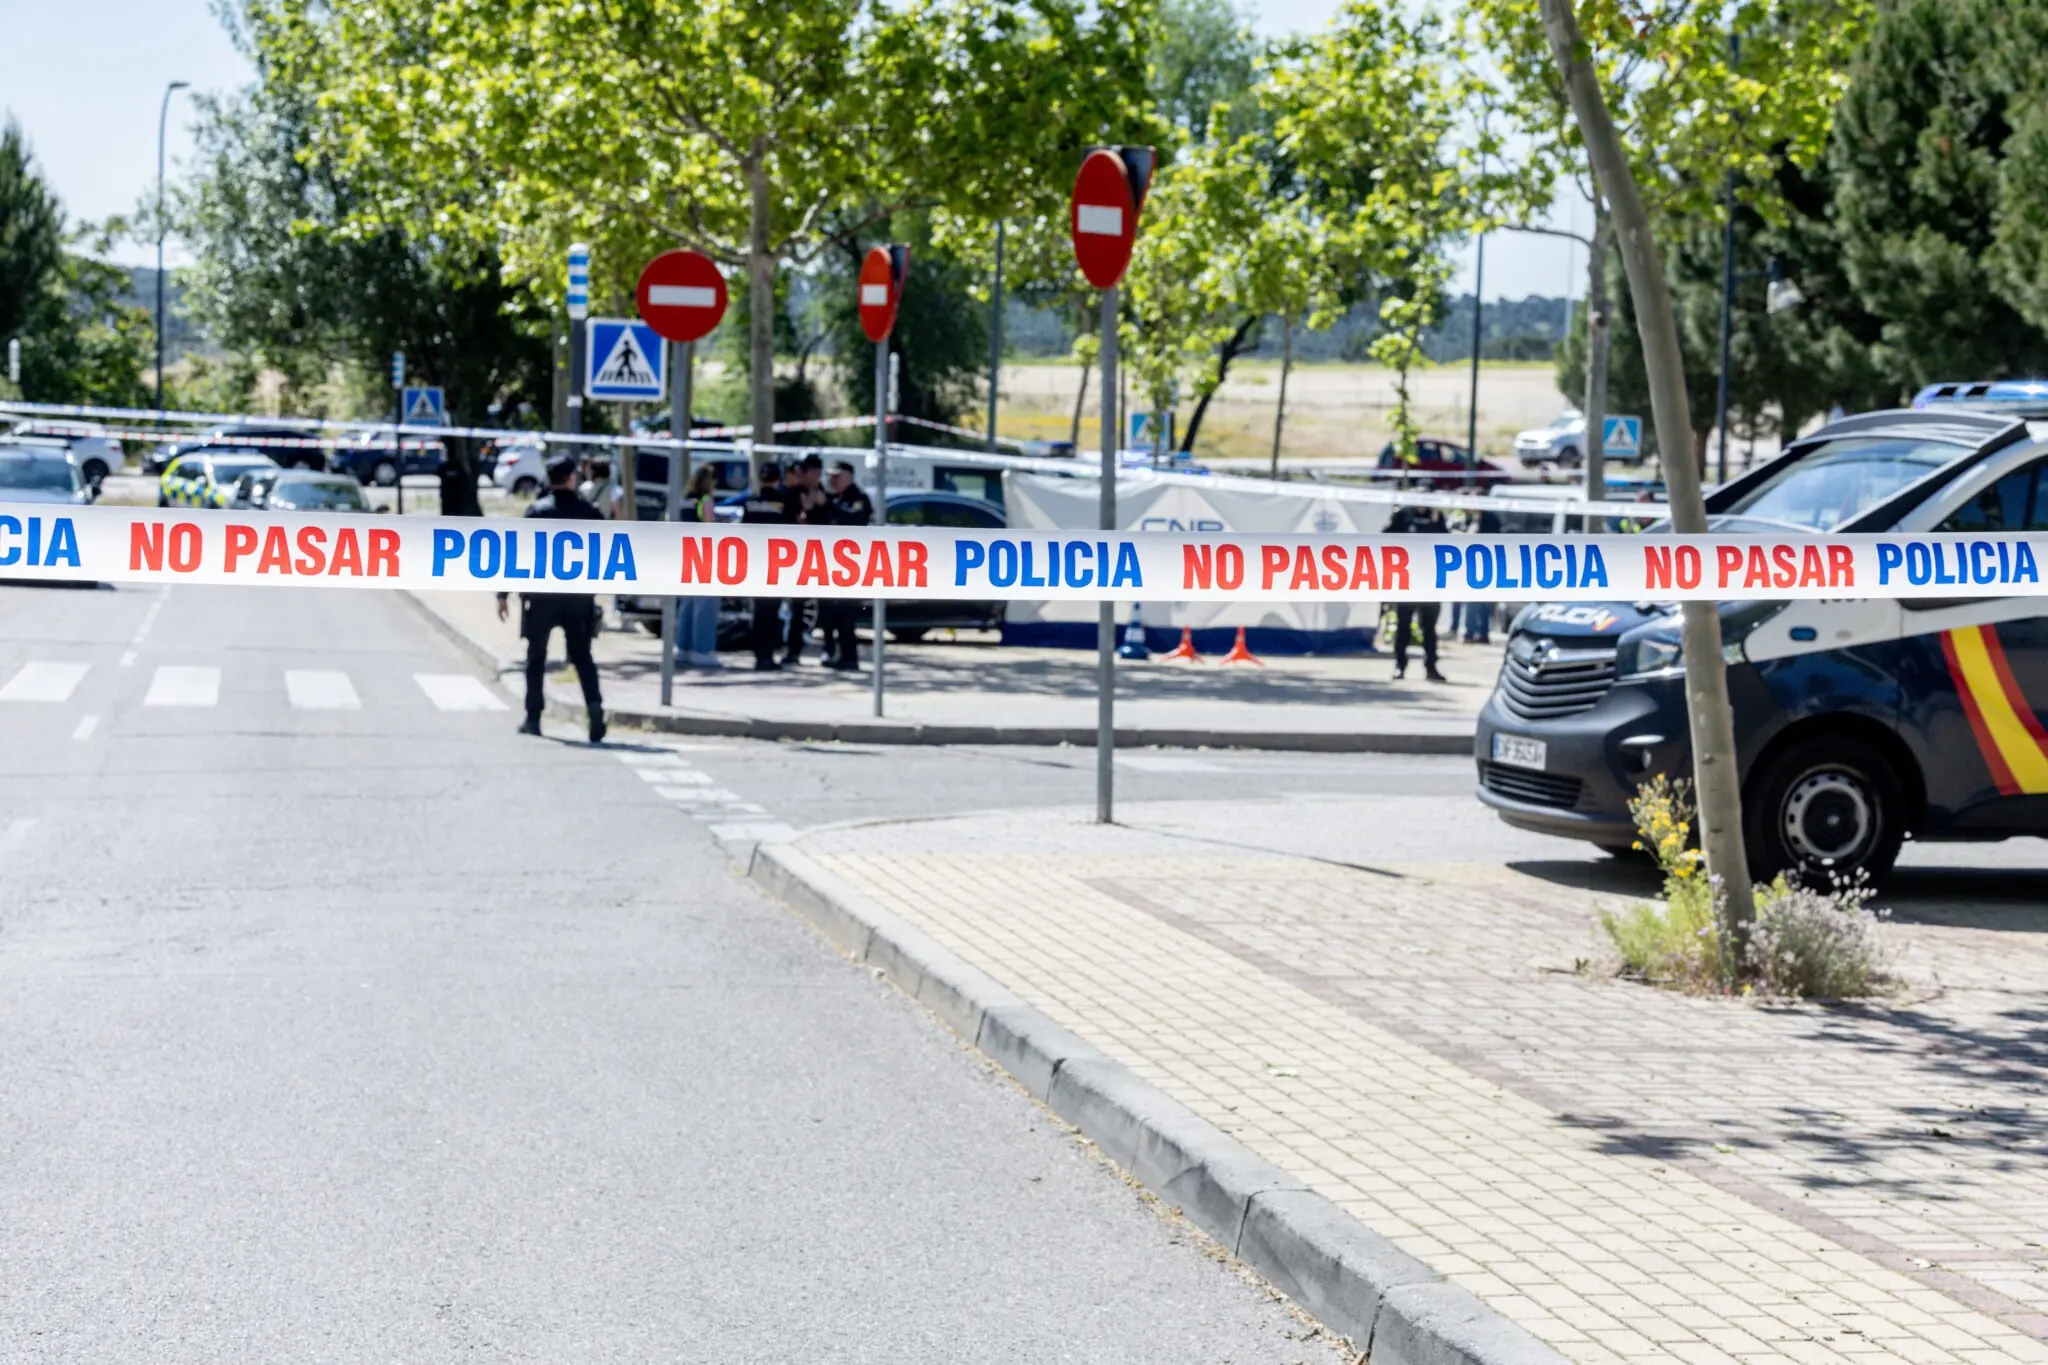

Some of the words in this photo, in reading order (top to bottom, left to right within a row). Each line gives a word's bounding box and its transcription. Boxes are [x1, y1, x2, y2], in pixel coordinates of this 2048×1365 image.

[130, 522, 203, 574] NO
[223, 524, 401, 577] PASAR
[431, 528, 637, 581] POLICIA
[681, 536, 748, 585] NO
[766, 538, 928, 588] PASAR
[954, 539, 1143, 589] POLICIA
[1183, 543, 1244, 590] NO
[1261, 544, 1409, 591] PASAR
[1433, 543, 1609, 590] POLICIA
[1644, 545, 1702, 590] NO
[1716, 544, 1854, 588] PASAR
[1876, 540, 2039, 587] POLICIA
